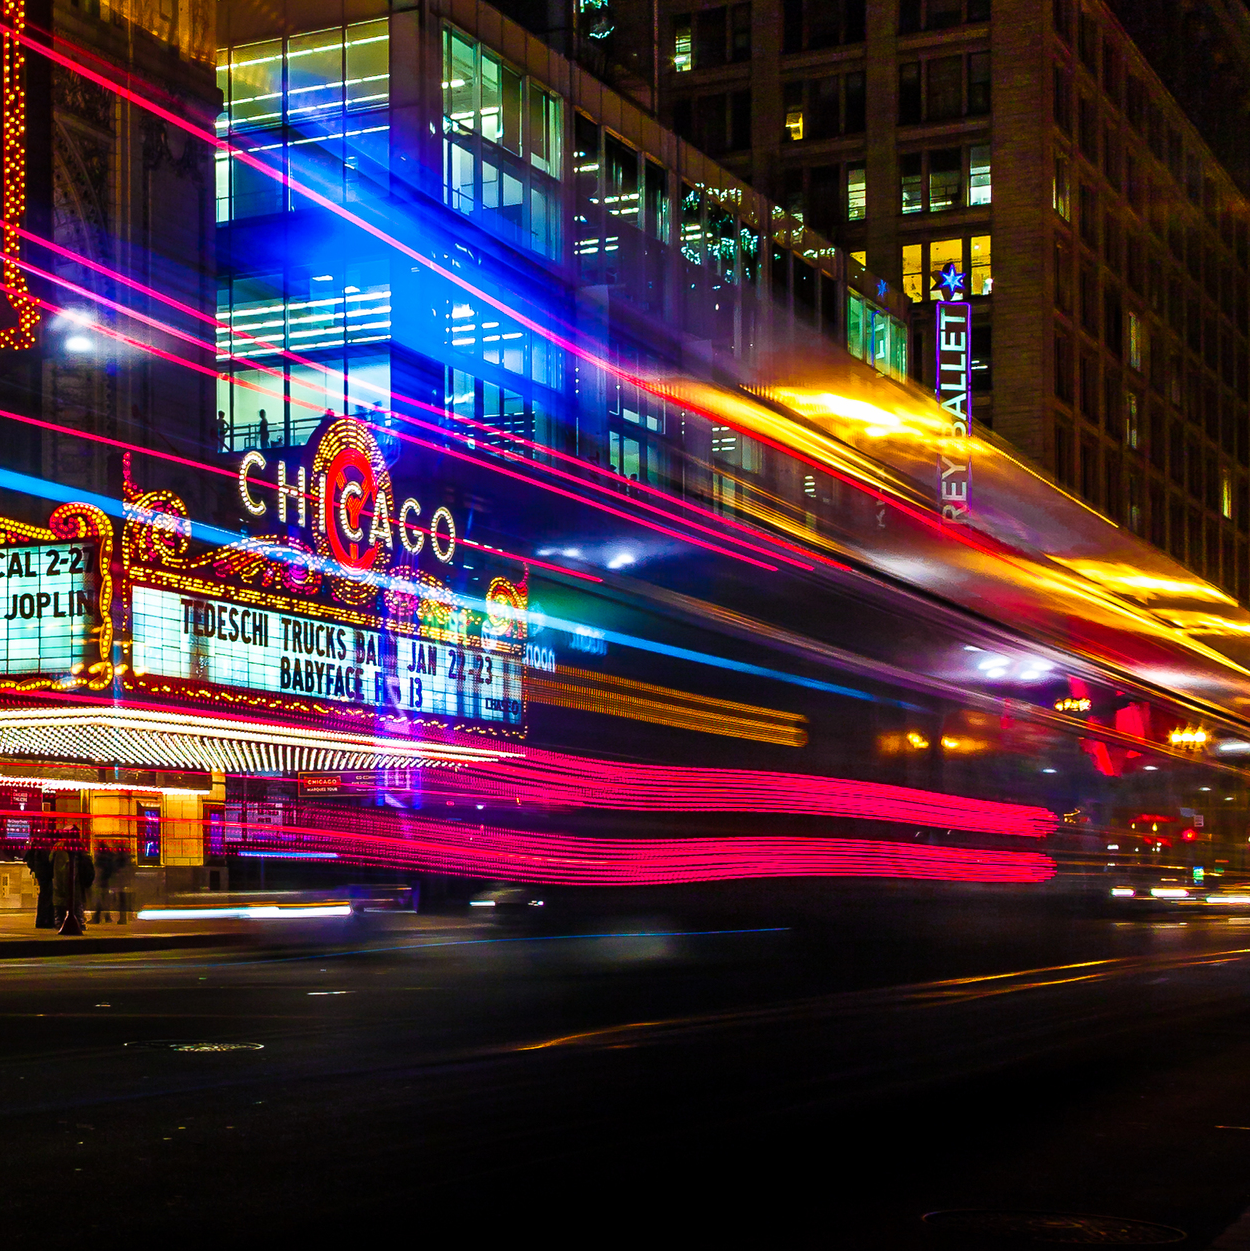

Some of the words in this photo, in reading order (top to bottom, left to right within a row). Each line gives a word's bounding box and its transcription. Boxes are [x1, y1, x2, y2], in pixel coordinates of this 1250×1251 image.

[238, 450, 456, 565] CHICAGO
[3, 590, 95, 621] JOPLIN
[180, 598, 269, 648] TEDESCHI
[281, 617, 347, 661] TRUCKS
[407, 641, 437, 680] JAN
[448, 650, 493, 686] 22-23
[280, 656, 364, 701] BABYFACE
[410, 676, 423, 708] 13
